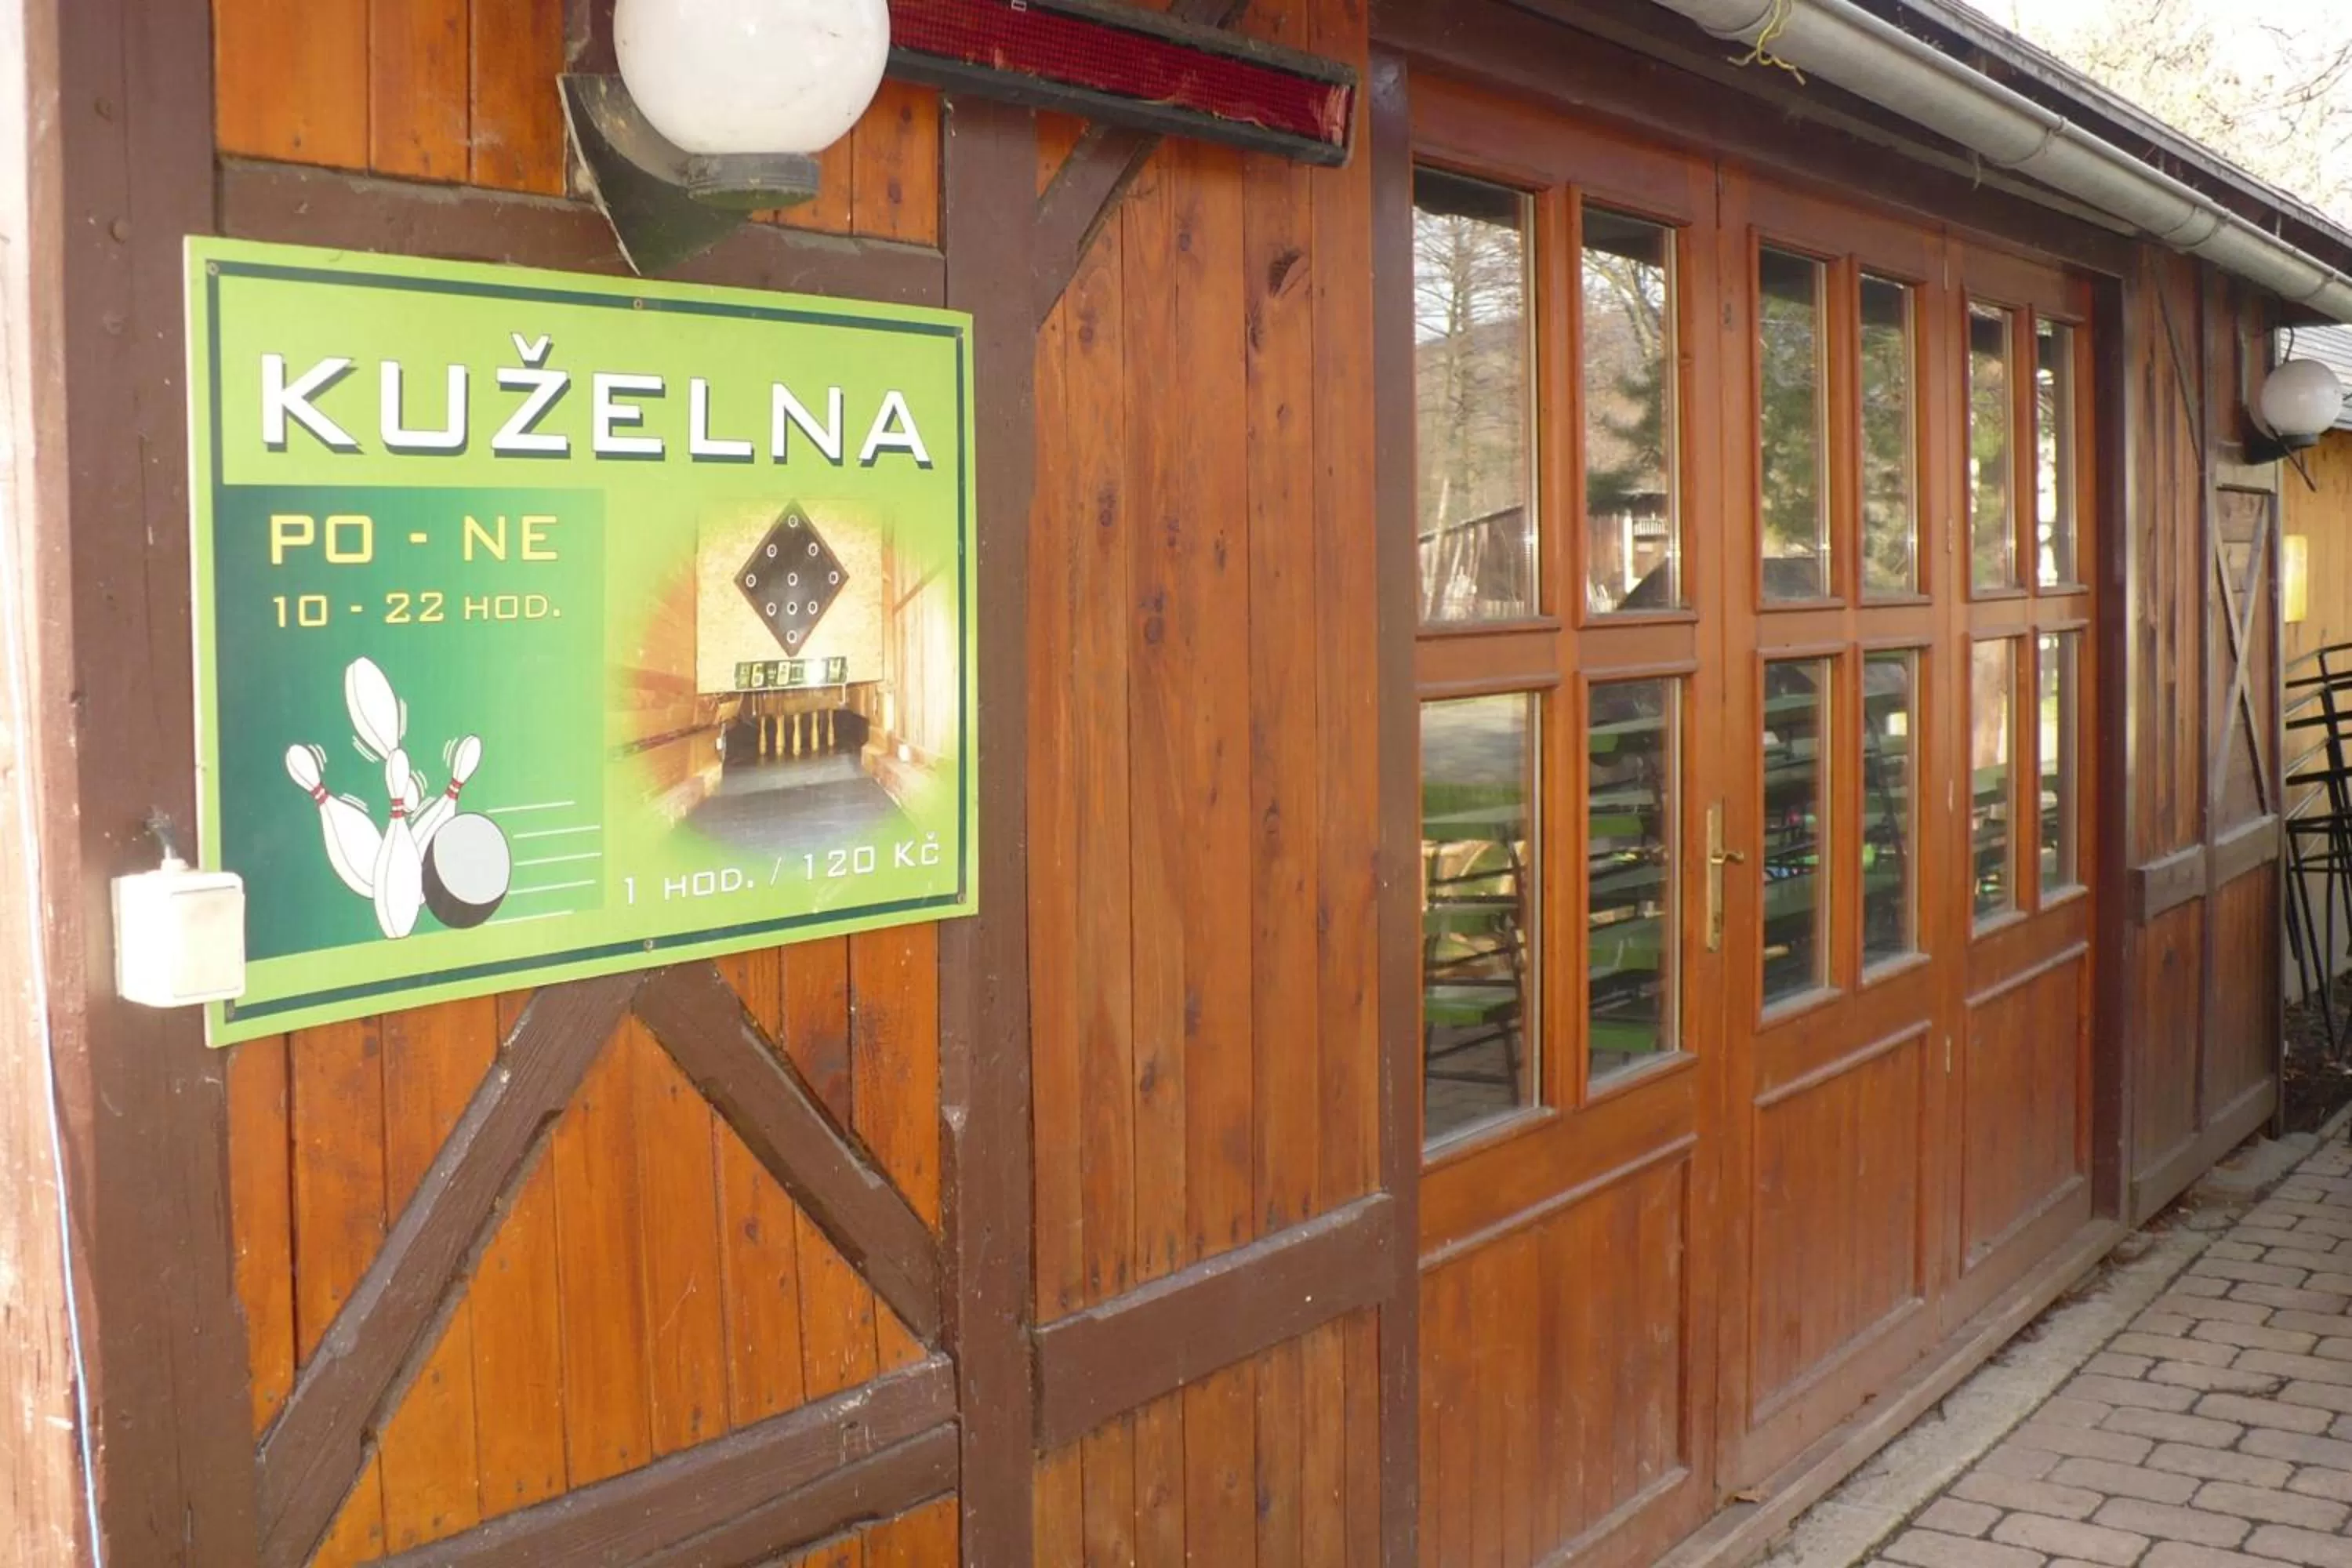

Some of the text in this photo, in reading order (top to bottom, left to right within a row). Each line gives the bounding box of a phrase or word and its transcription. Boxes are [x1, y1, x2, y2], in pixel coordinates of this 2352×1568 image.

[260, 331, 933, 469] KUŽELNA
[270, 514, 558, 565] PO - NE
[272, 591, 562, 628] 10 - 22 HOD.
[623, 876, 634, 905] 1
[663, 867, 754, 901] HOD.
[769, 856, 782, 887] /
[802, 845, 876, 881] 120
